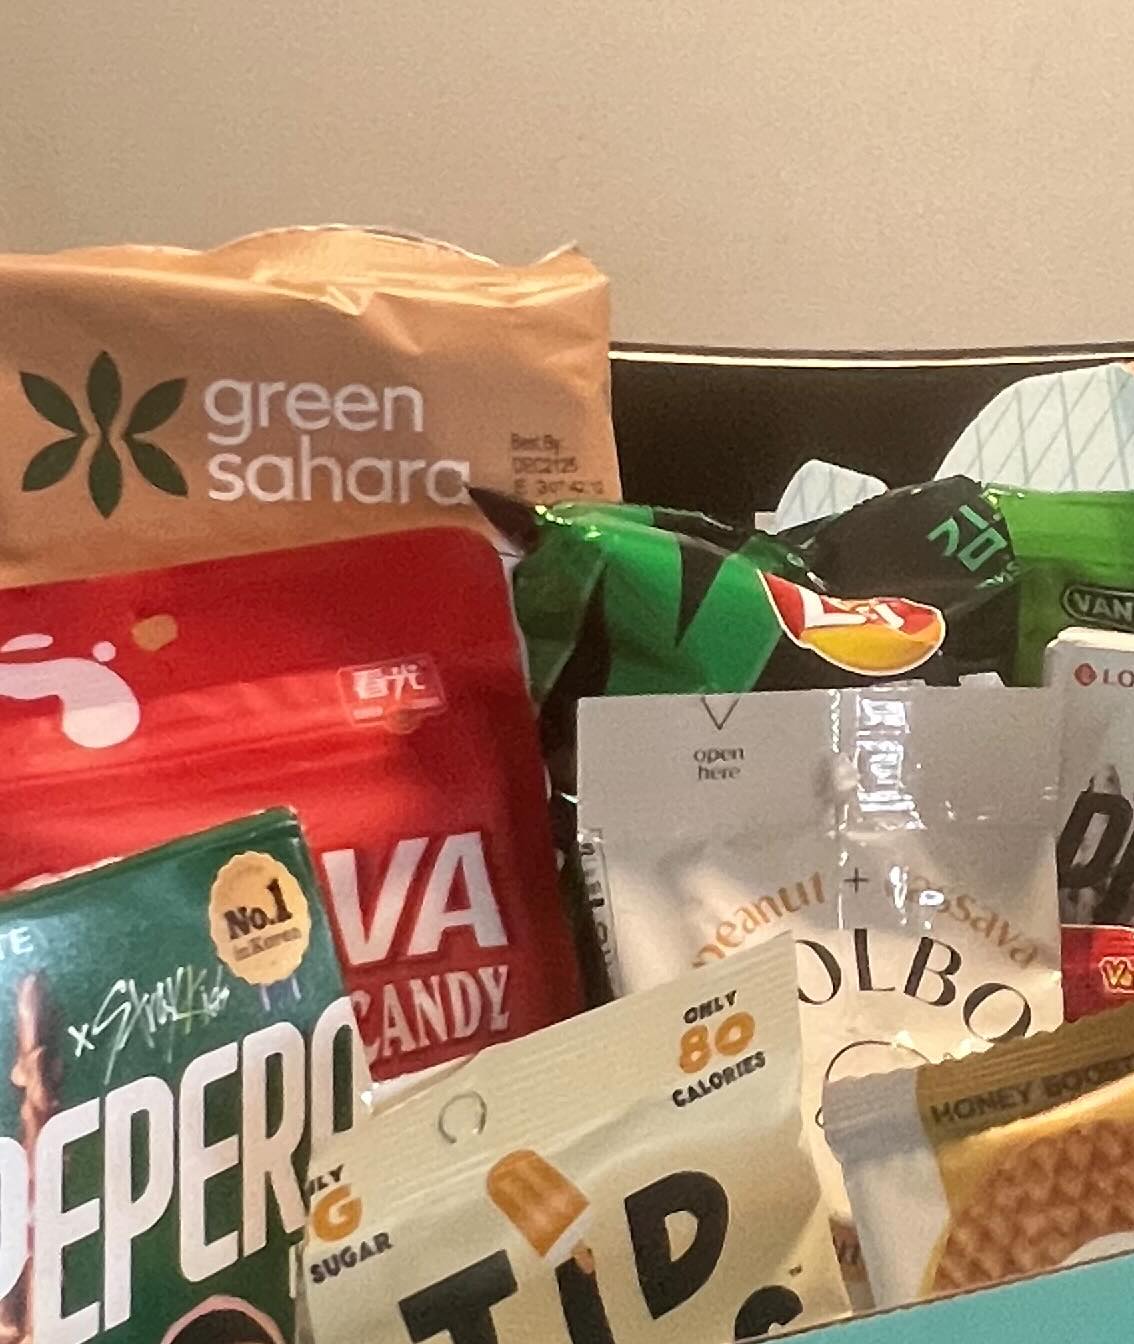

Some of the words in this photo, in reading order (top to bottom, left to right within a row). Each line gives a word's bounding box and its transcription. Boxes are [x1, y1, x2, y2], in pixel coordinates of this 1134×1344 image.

[204, 377, 424, 446] green
[207, 435, 472, 505] sahara
[927, 504, 1008, 572] 김
[1073, 592, 1134, 623] VAN
[693, 747, 745, 766] open
[697, 764, 742, 781] here
[223, 877, 294, 941] No.1
[320, 830, 510, 967] VA
[682, 989, 737, 1024] ONLY
[797, 927, 1032, 1045] OLBO
[679, 1010, 756, 1074] 80
[672, 1051, 766, 1108] CALORIES
[929, 1080, 1033, 1124] HONEY
[312, 1183, 363, 1244] G
[310, 1231, 394, 1284] SUGAR
